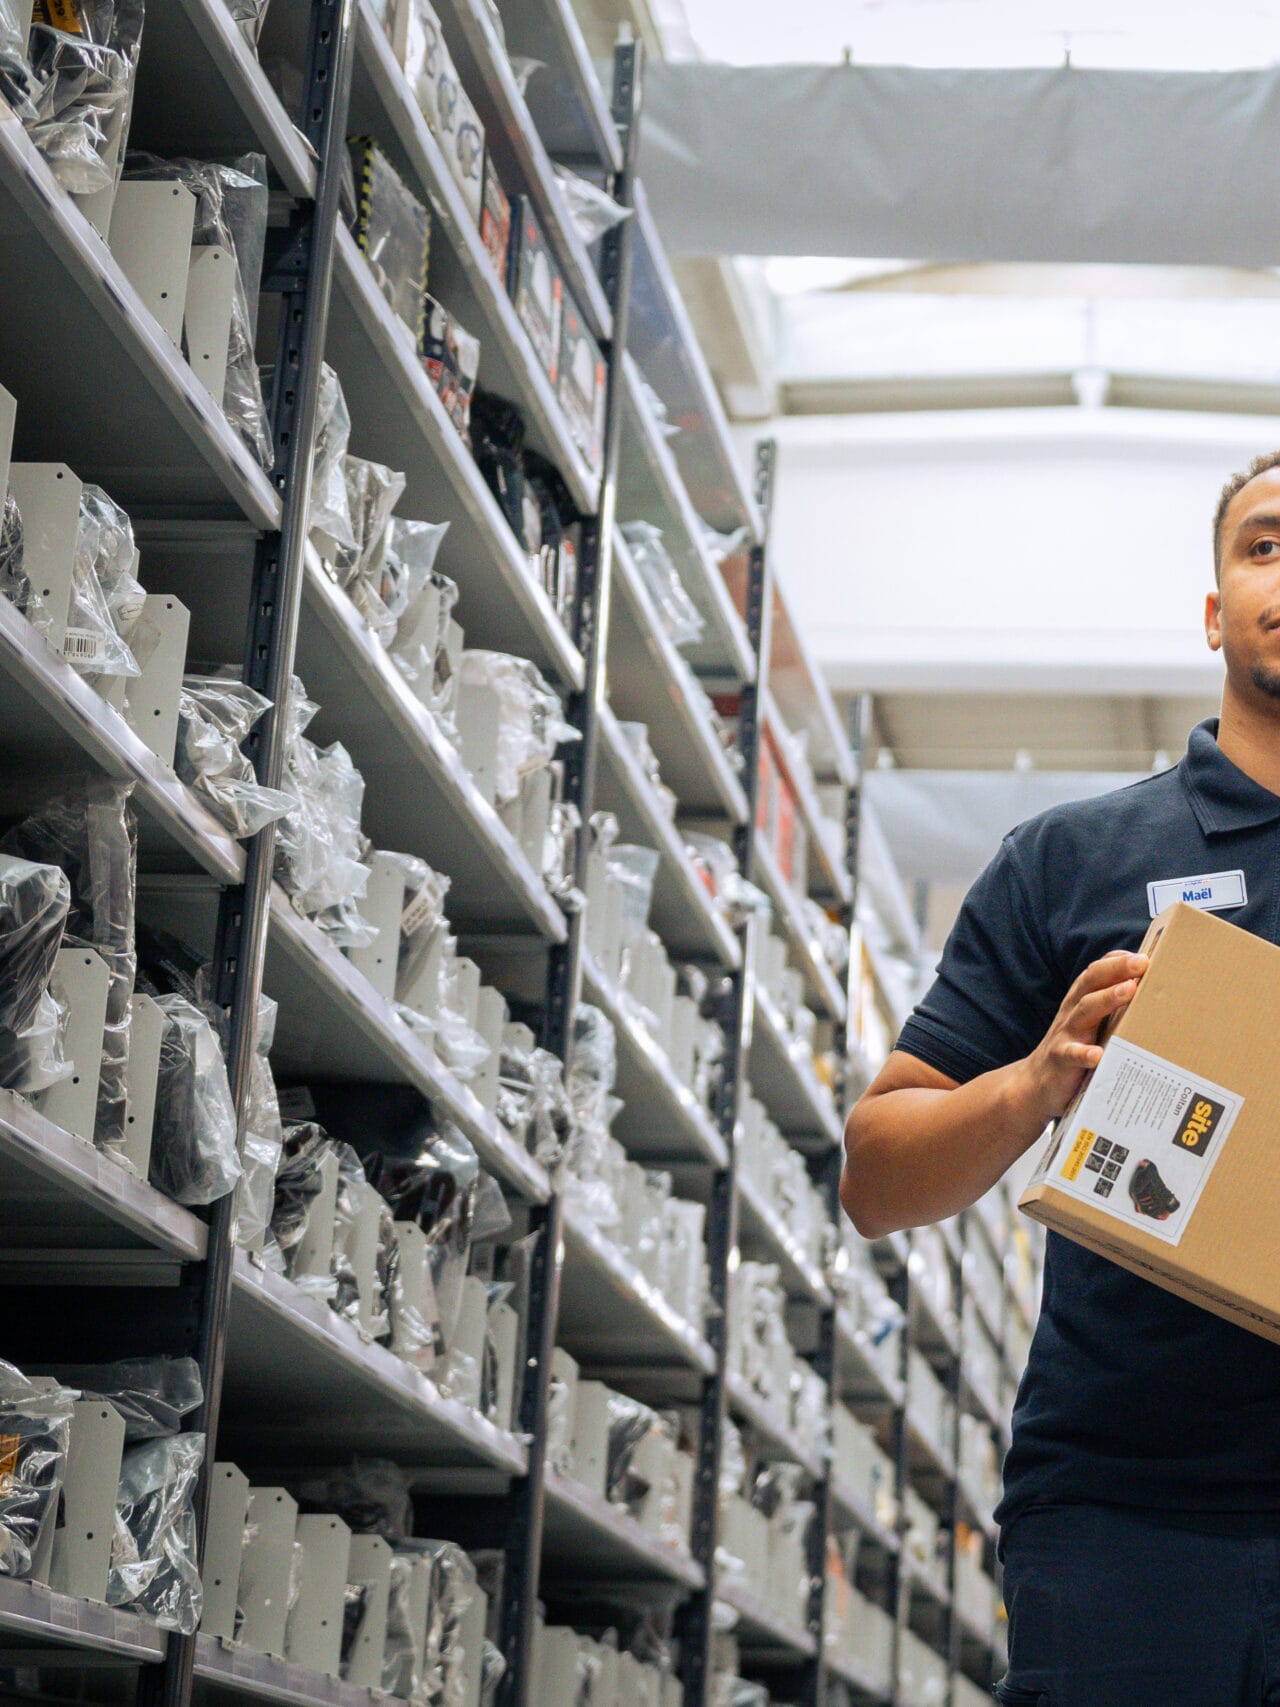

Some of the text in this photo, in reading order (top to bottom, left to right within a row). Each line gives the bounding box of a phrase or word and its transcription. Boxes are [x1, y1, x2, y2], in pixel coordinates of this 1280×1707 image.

[1182, 887, 1213, 902] Maël
[1173, 1086, 1192, 1117] Coltan
[1181, 1101, 1213, 1147] site
